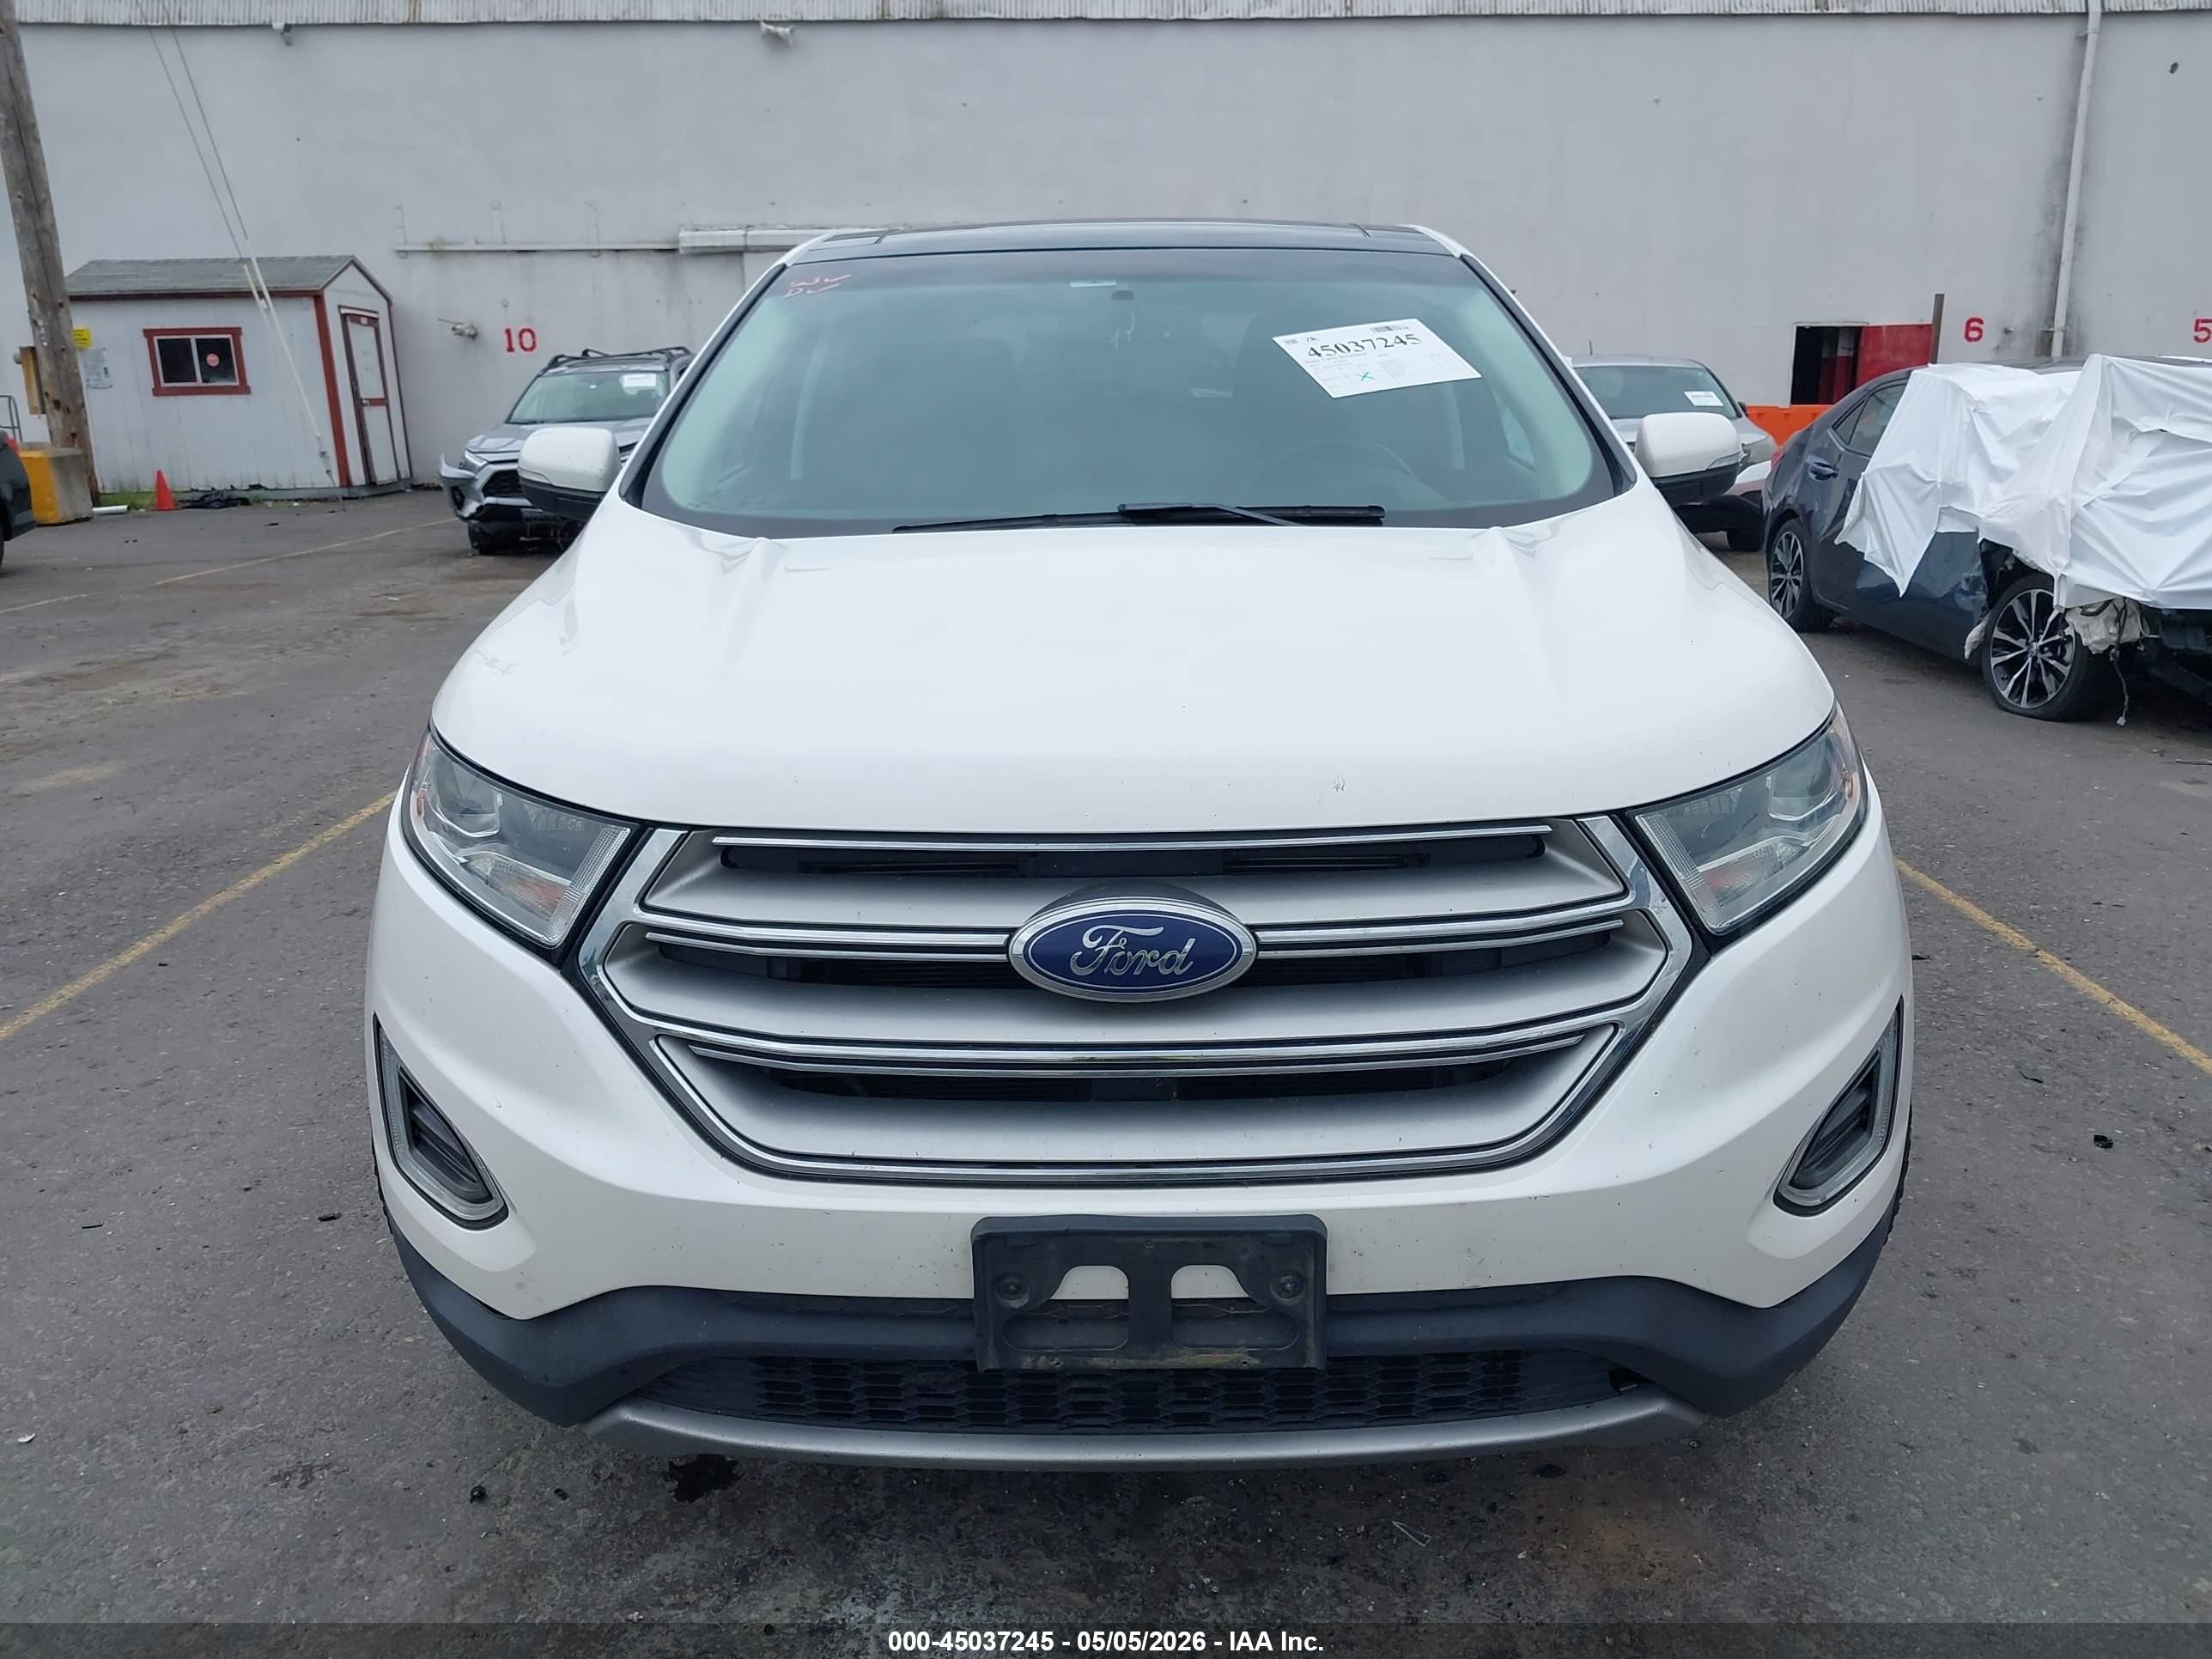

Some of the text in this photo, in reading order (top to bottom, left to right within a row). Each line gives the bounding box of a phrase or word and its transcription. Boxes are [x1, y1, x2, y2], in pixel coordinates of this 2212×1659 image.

[505, 328, 537, 352] 10
[1963, 316, 1984, 342] 6
[2193, 318, 2212, 343] 5
[1308, 333, 1421, 357] 45037245
[1070, 925, 1196, 976] Ford
